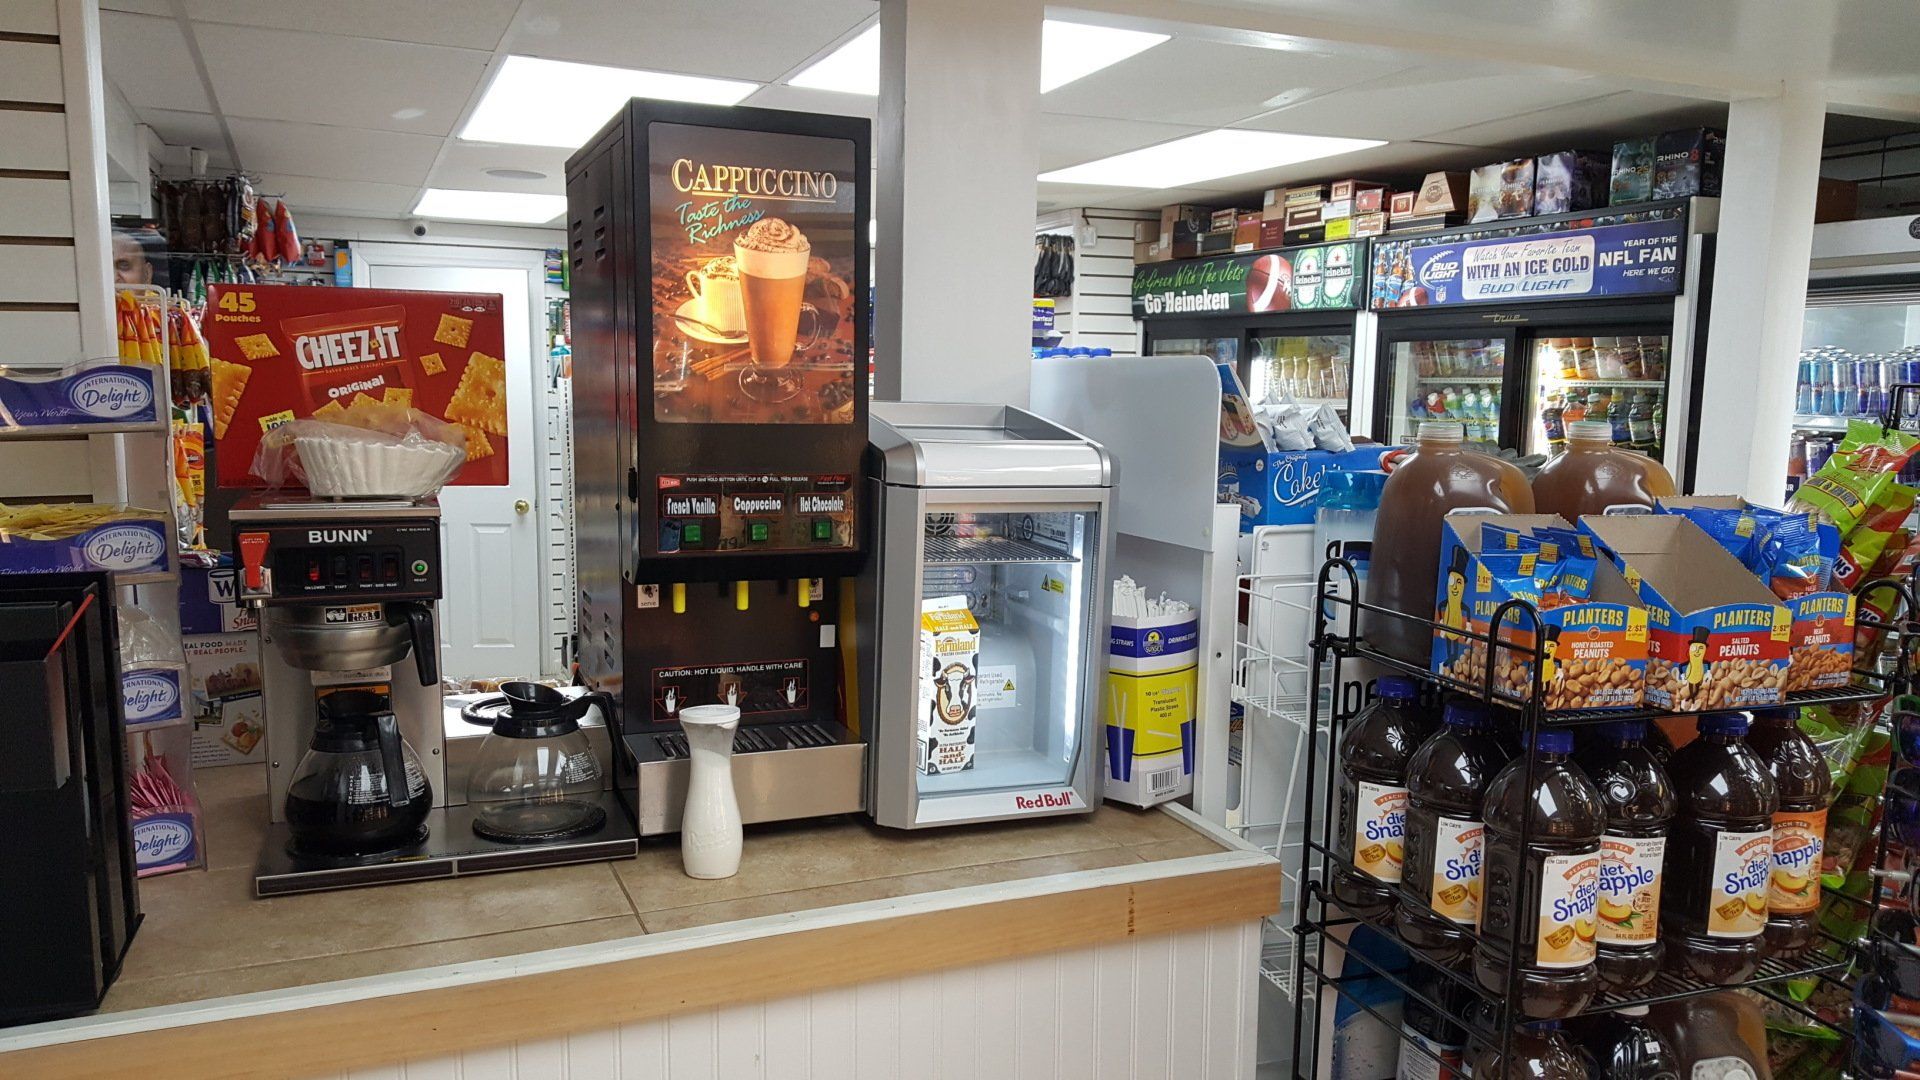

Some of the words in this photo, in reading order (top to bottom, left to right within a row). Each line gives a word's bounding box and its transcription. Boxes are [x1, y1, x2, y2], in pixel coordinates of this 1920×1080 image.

[1657, 151, 1688, 162] RHINO
[671, 158, 837, 198] CAPPUCCINO
[1613, 167, 1635, 176] RHINO
[675, 201, 720, 225] Taste
[723, 195, 751, 212] the
[685, 209, 765, 244] Richness
[1474, 249, 1498, 262] Watch
[1500, 246, 1518, 260] Your
[1521, 243, 1557, 257] Favorite
[1562, 239, 1581, 254] Team
[1624, 239, 1645, 248] YEAR
[1600, 250, 1634, 267] NFL
[1639, 246, 1677, 263] FAN
[1425, 270, 1459, 278] LIGHT
[1433, 262, 1458, 272] BUD
[1466, 264, 1500, 279] WITH
[1504, 262, 1520, 276] AN
[1525, 259, 1547, 275] ICE
[1553, 256, 1589, 273] COLD
[1623, 268, 1645, 277] HERE
[1647, 267, 1660, 275] WE
[1661, 266, 1675, 274] GO
[1147, 269, 1173, 290] Green
[1175, 265, 1195, 287] With
[1199, 263, 1217, 283] The
[1219, 260, 1244, 283] Jets
[1479, 283, 1515, 294] BUD
[1521, 279, 1573, 291] LIGHT
[219, 292, 256, 313] 45
[1144, 293, 1163, 314] Go
[1164, 289, 1230, 312] Heineken
[215, 314, 261, 323] Pouches
[84, 375, 138, 390] INTERNATIONAL
[82, 388, 141, 410] Delight
[1285, 454, 1308, 463] Original
[668, 498, 690, 515] French
[692, 497, 716, 515] Vanilla
[734, 497, 781, 514] Cappuccino
[800, 496, 811, 512] Hot
[811, 496, 844, 512] Chocolate
[98, 530, 151, 543] INTERNATIONAL
[308, 530, 368, 543] BUNN
[97, 541, 154, 563] Delight
[1799, 597, 1843, 616] PLANTERS
[1563, 608, 1624, 628] PLANTERS
[1713, 609, 1772, 629] PLANTERS
[935, 638, 976, 653] Farmland
[1116, 639, 1134, 647] STRAWS
[1804, 634, 1830, 645] PEANUTS
[1573, 649, 1609, 659] PEANUTS
[1720, 644, 1759, 657] PEANUTS
[659, 670, 693, 678] CAUTION:
[710, 667, 735, 675] LIQUID,
[736, 664, 764, 672] HANDLE
[939, 745, 965, 753] HALF
[939, 757, 965, 765] HALF
[1016, 796, 1043, 809] Red
[1043, 792, 1071, 807] Bull
[1380, 794, 1402, 802] PEACH
[1615, 844, 1629, 852] TEA
[1569, 862, 1589, 876] PEACH
[1748, 857, 1767, 874] diet
[1576, 881, 1595, 899] diet
